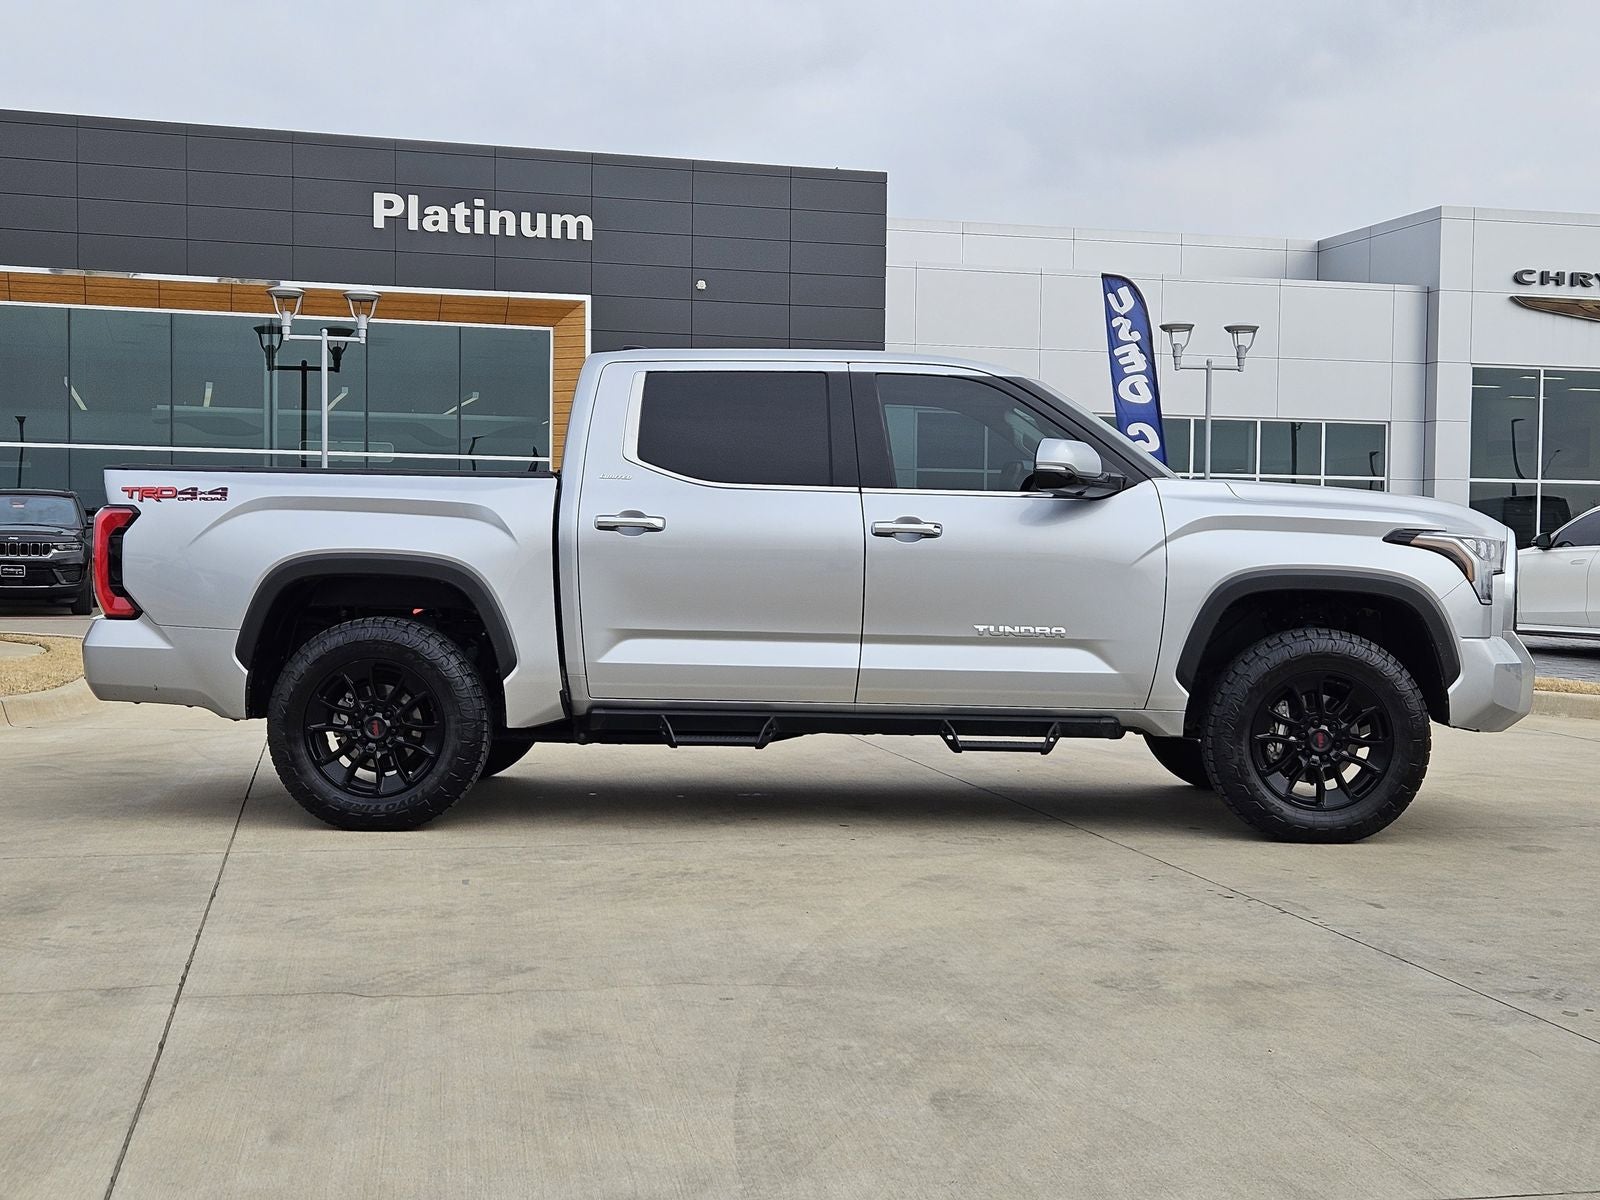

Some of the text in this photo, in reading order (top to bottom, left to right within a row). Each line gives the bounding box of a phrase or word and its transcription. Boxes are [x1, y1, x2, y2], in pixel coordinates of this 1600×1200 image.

[373, 191, 593, 241] Platinum
[1512, 269, 1600, 288] CHR
[121, 487, 177, 502] TRD
[973, 624, 1067, 638] TUNDRA
